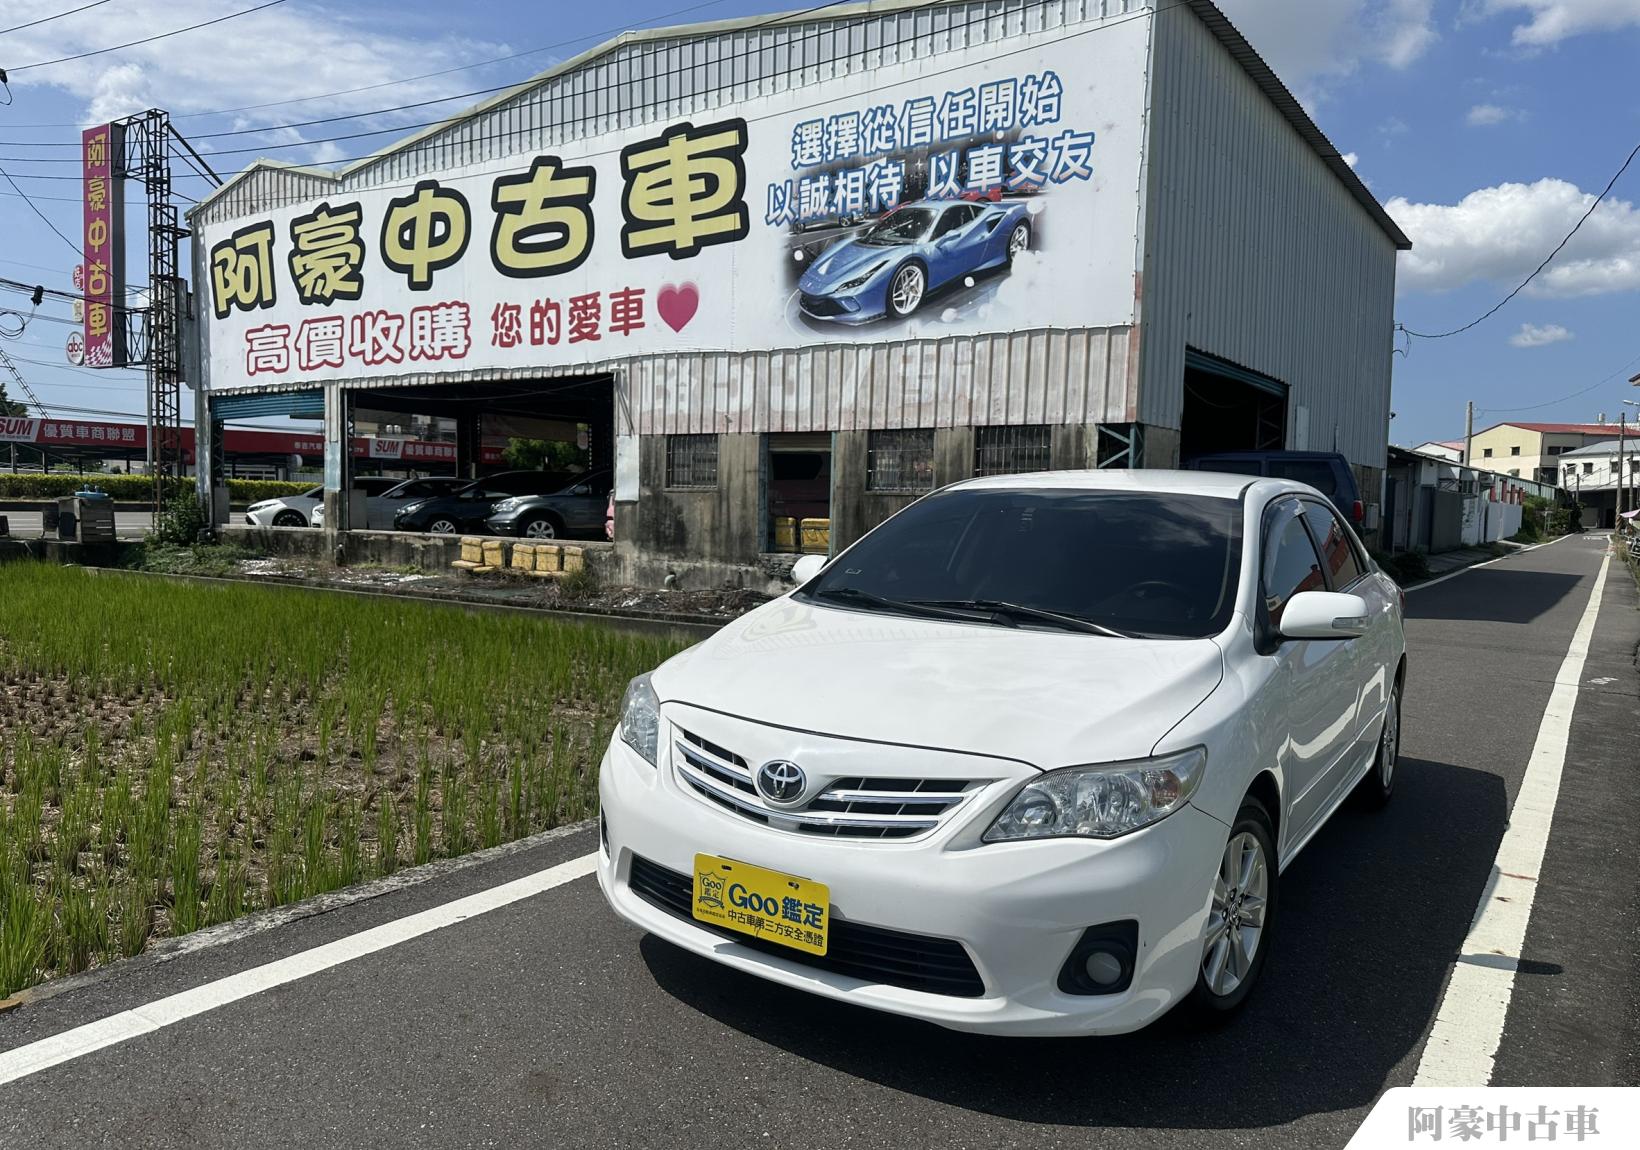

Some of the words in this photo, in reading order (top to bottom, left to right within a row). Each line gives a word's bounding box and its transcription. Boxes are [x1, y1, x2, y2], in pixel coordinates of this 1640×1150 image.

[791, 71, 1063, 169] 選擇從信任開始
[765, 160, 904, 226] 以誠相待
[926, 130, 1095, 201] 以車交友
[87, 132, 107, 338] 阿豪中古車
[212, 117, 750, 319] 阿豪中古車
[246, 301, 471, 375] 高價收購
[491, 287, 646, 349] 您的愛車
[43, 423, 135, 441] 優質車商聯盟
[375, 440, 399, 453] SUM
[702, 877, 722, 890] Goo
[728, 883, 779, 917] Goo
[781, 896, 824, 930] 鑑定
[727, 908, 824, 947] 中古車第三方安全憑證
